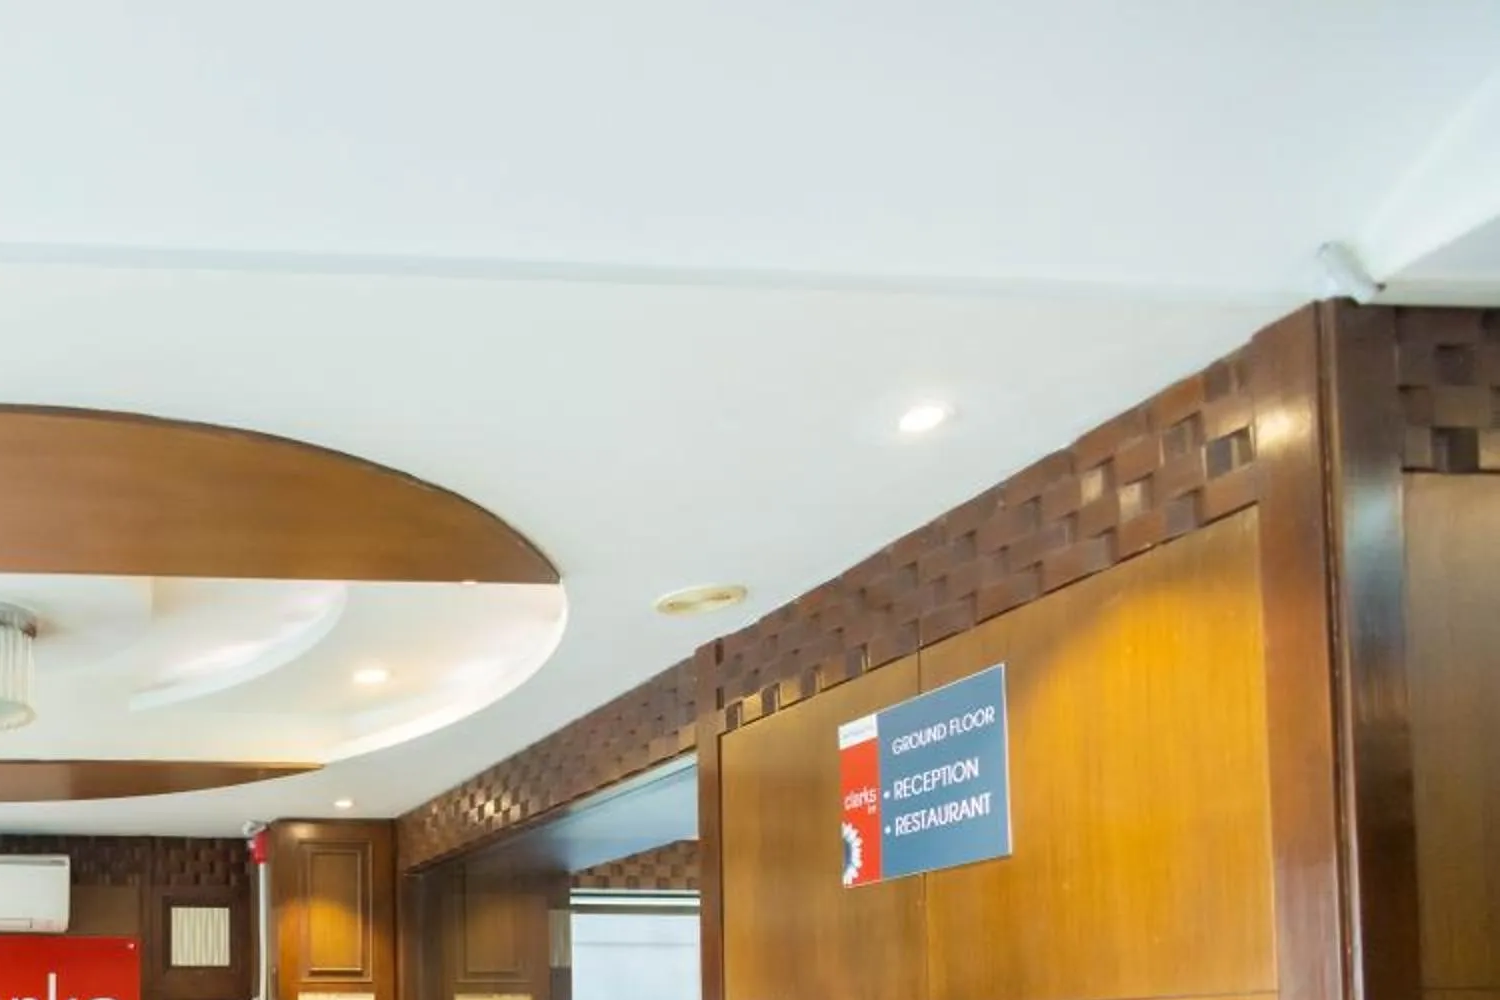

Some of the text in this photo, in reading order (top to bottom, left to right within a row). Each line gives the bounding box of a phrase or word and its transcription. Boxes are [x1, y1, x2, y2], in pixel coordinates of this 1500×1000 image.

[892, 705, 995, 755] GROUND FLOOR
[893, 757, 979, 799] RECEPTION
[895, 793, 991, 836] RESTAURANT
